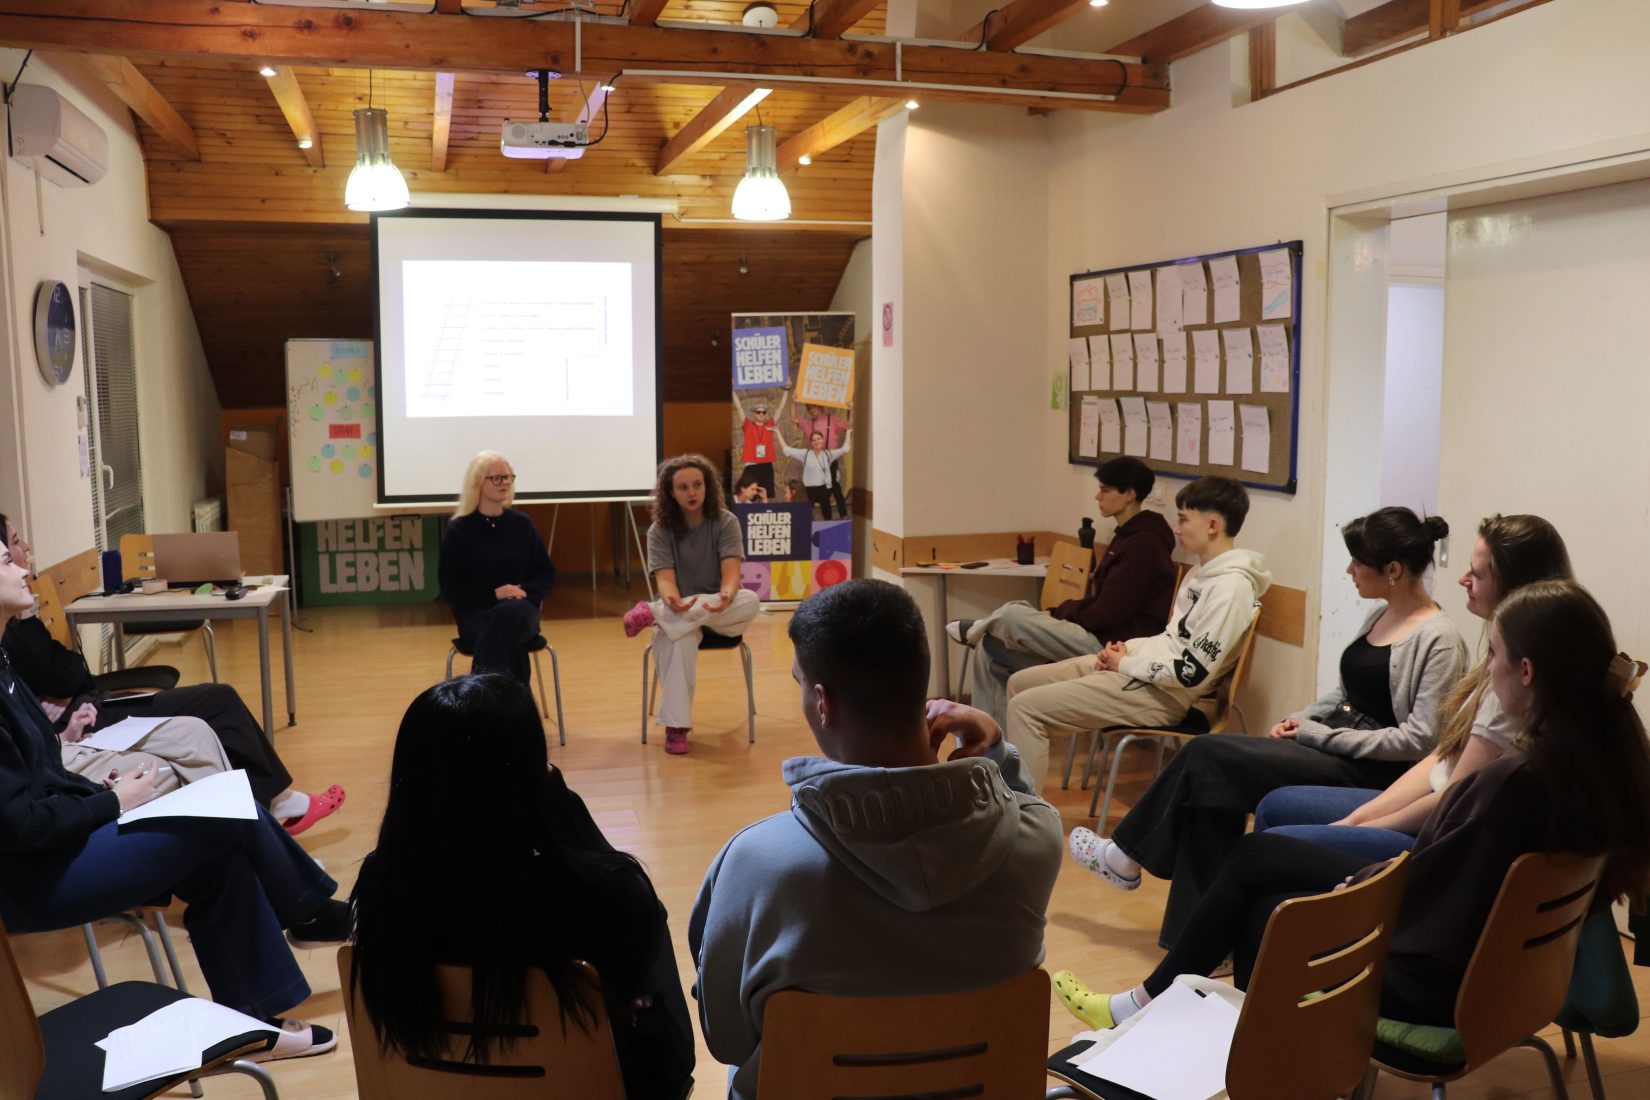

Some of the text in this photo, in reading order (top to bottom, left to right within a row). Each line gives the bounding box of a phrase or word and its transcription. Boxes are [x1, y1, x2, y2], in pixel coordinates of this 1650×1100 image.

[735, 333, 781, 351] SCHÜLER
[736, 349, 782, 367] HELFEN
[737, 364, 784, 385] LEBEN
[804, 365, 851, 385] HELFEN
[801, 380, 847, 403] LEBEN
[747, 509, 791, 526] SCHÜLER
[317, 518, 423, 551] HELFEN
[747, 525, 791, 539] HELFEN
[747, 539, 791, 556] LEBEN
[319, 551, 424, 593] LEBEN
